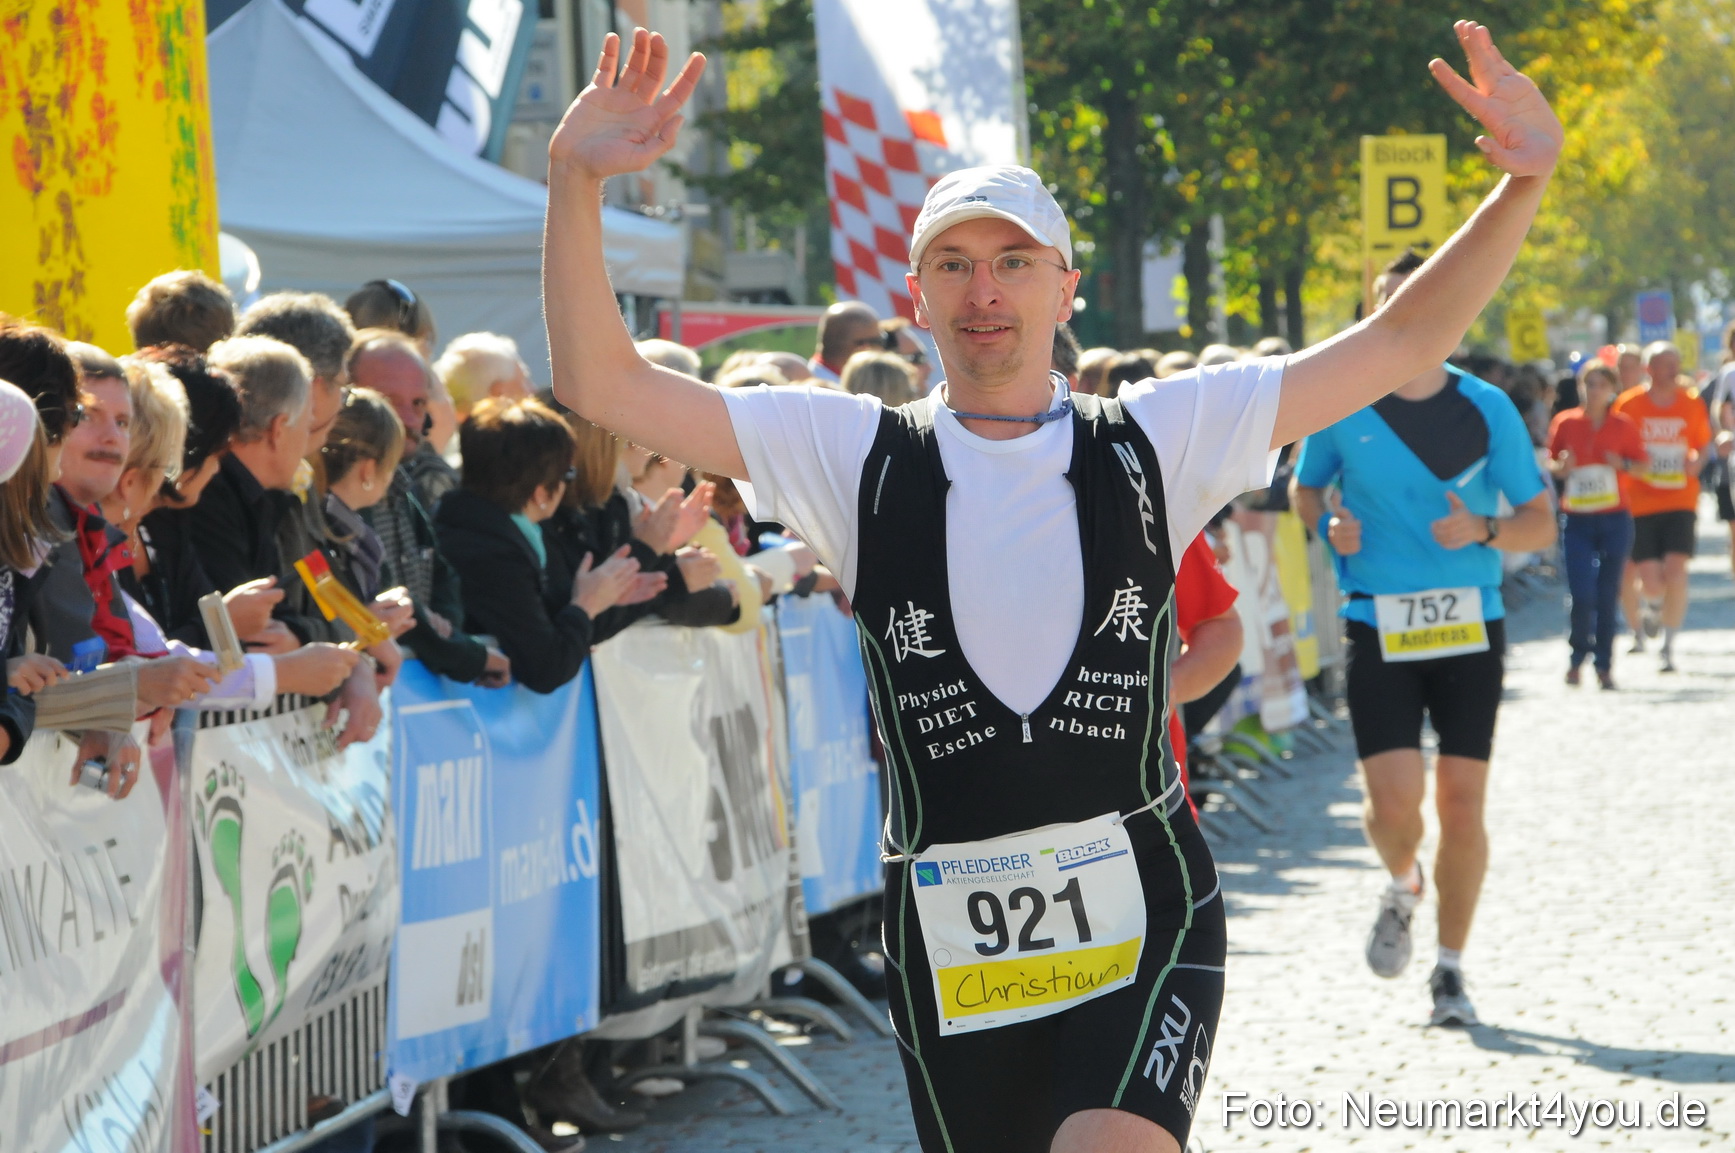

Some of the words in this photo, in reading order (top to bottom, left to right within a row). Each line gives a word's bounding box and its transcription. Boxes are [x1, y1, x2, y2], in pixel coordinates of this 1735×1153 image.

[1386, 175, 1424, 230] B
[884, 600, 947, 664] 健
[1093, 577, 1150, 643] 康
[1399, 593, 1461, 627] 752
[1400, 626, 1471, 648] Andreas
[897, 677, 969, 711] Physiot
[1077, 665, 1149, 690] herapie
[917, 700, 978, 735] DIET
[1063, 689, 1133, 714] RICH
[926, 725, 997, 761] Esche
[1049, 716, 1127, 741] nbach
[411, 731, 483, 871] maxi
[941, 852, 1033, 875] PFLEIDERER
[1055, 837, 1111, 864] BOCK
[946, 870, 1036, 885] AKTIENGESELLSCHAFT
[966, 876, 1092, 957] 921
[955, 960, 1120, 1009] Christian
[1143, 993, 1192, 1093] 2XU
